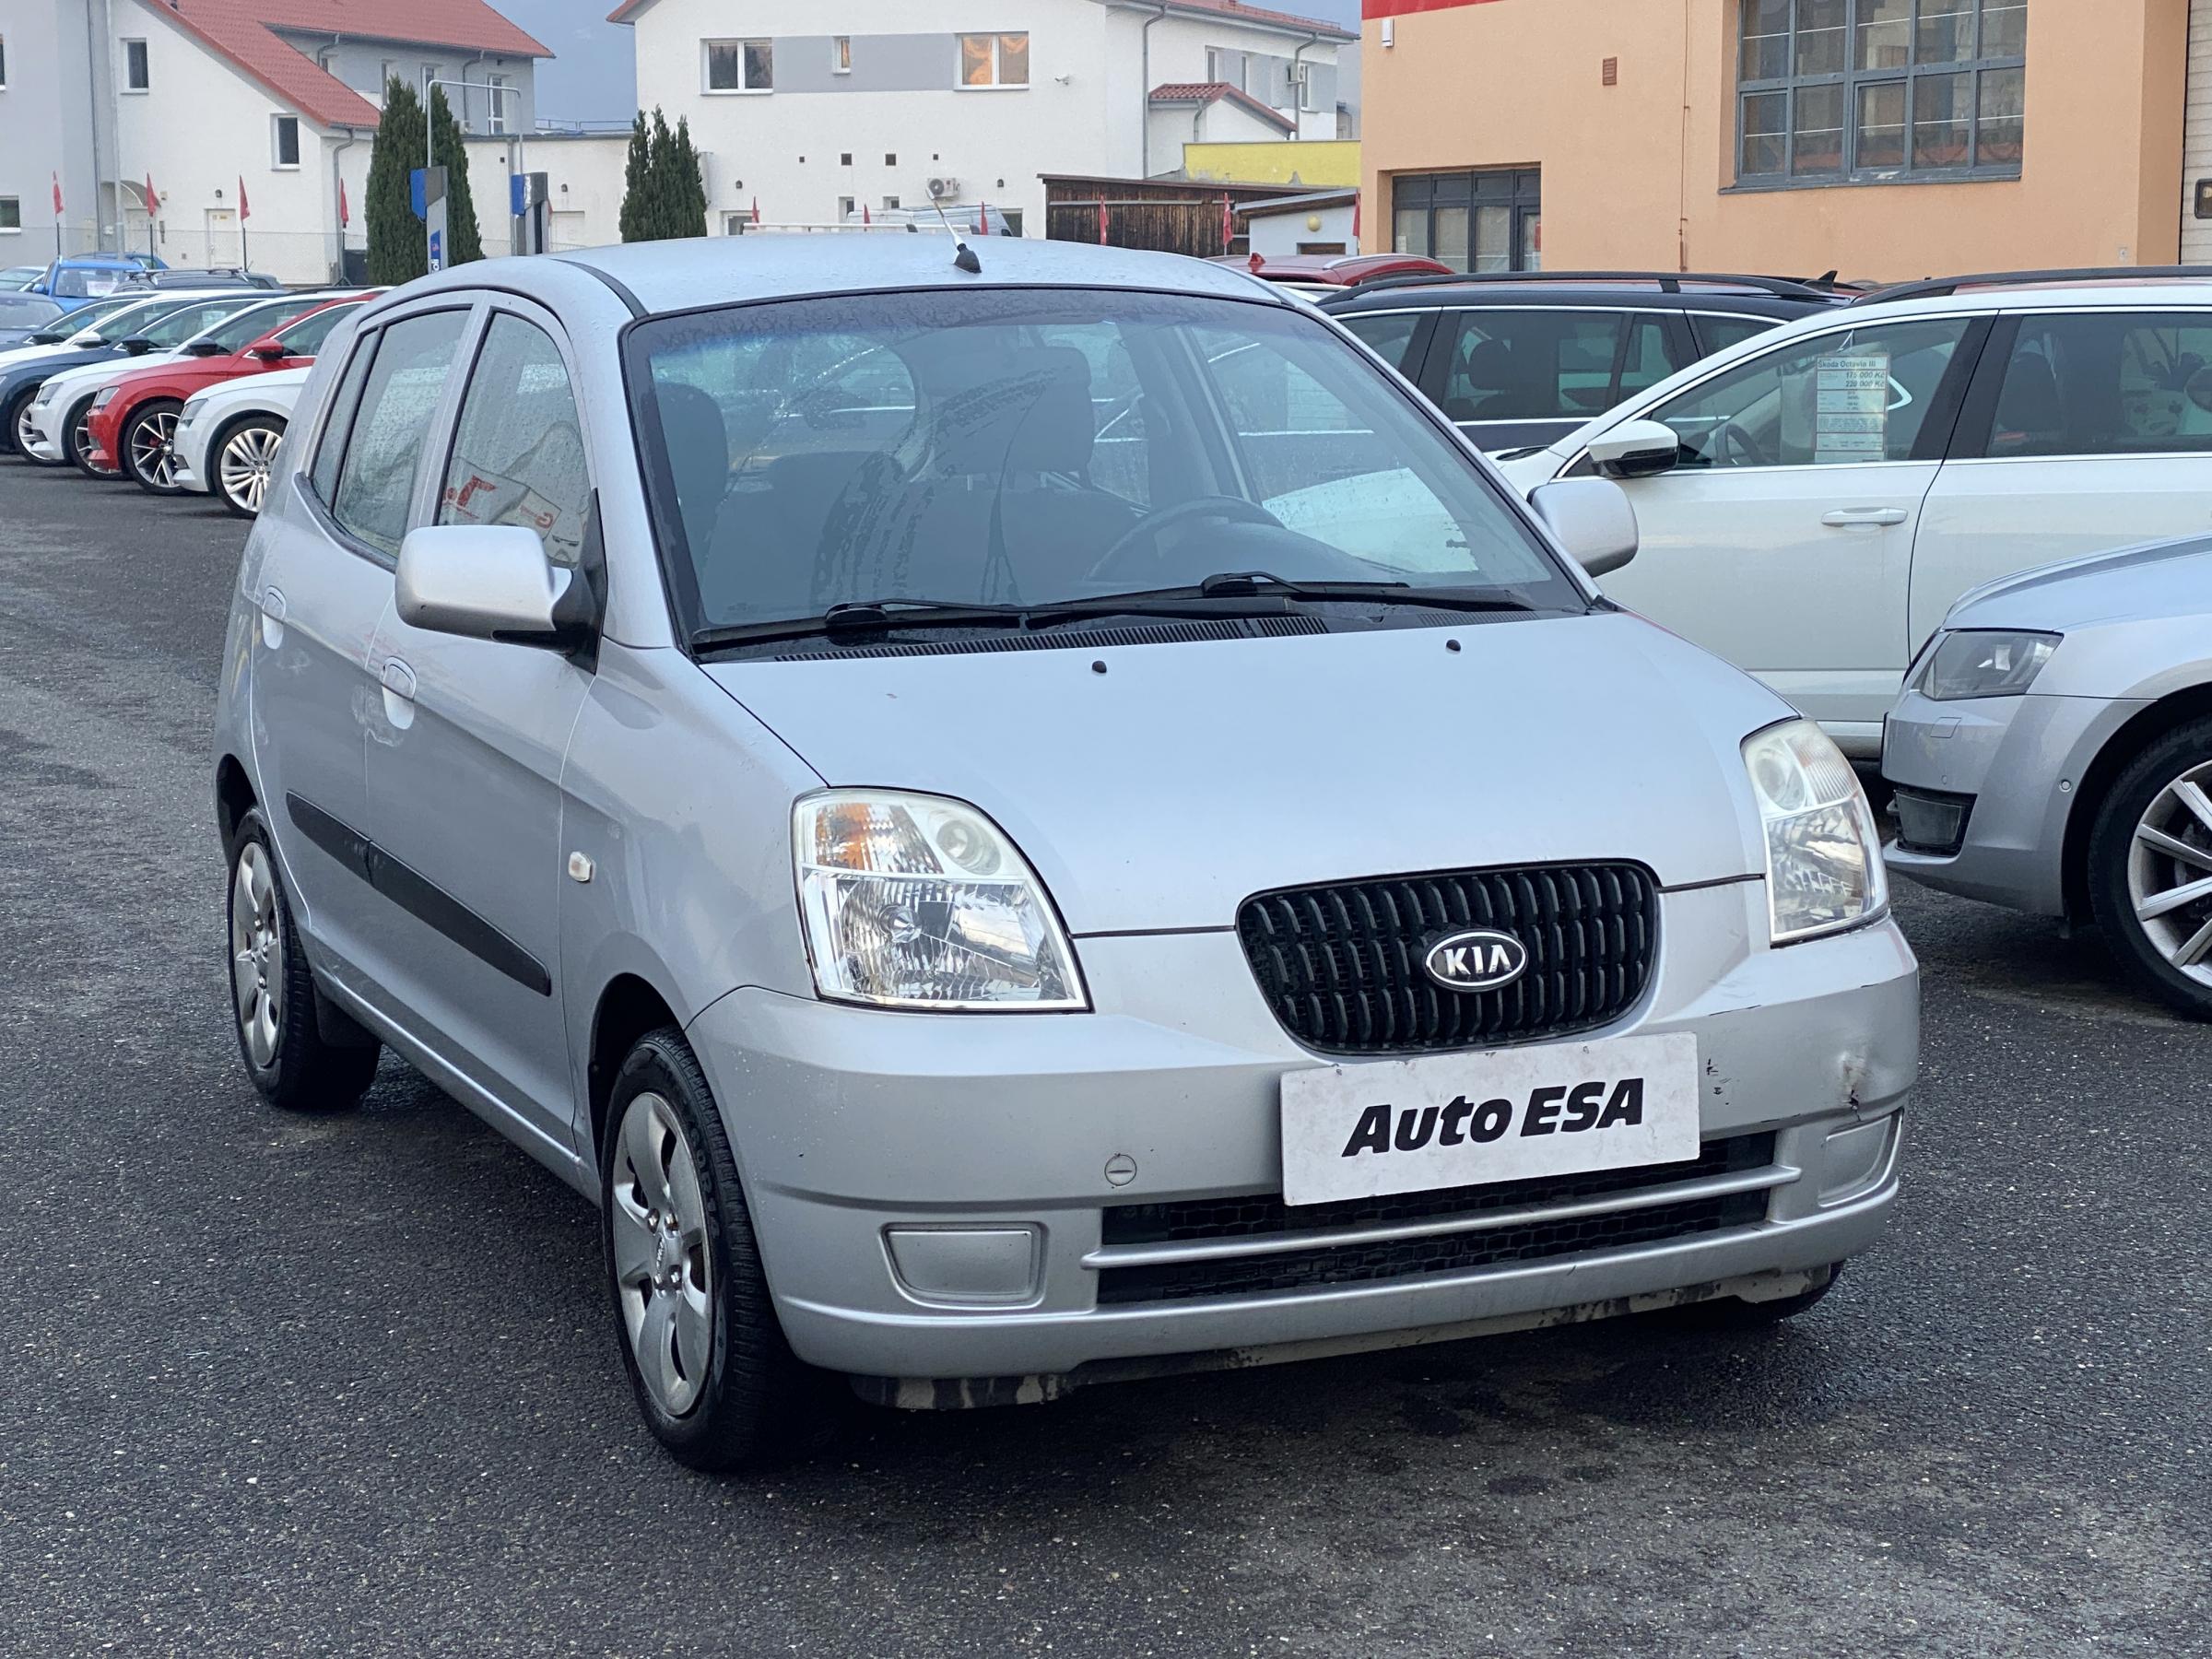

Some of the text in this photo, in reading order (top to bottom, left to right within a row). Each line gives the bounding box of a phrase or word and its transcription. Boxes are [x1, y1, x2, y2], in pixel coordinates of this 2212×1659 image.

[1818, 359, 1839, 368] Škoda
[1443, 944, 1512, 976] KIA
[1342, 1077, 1644, 1157] Auto ESA
